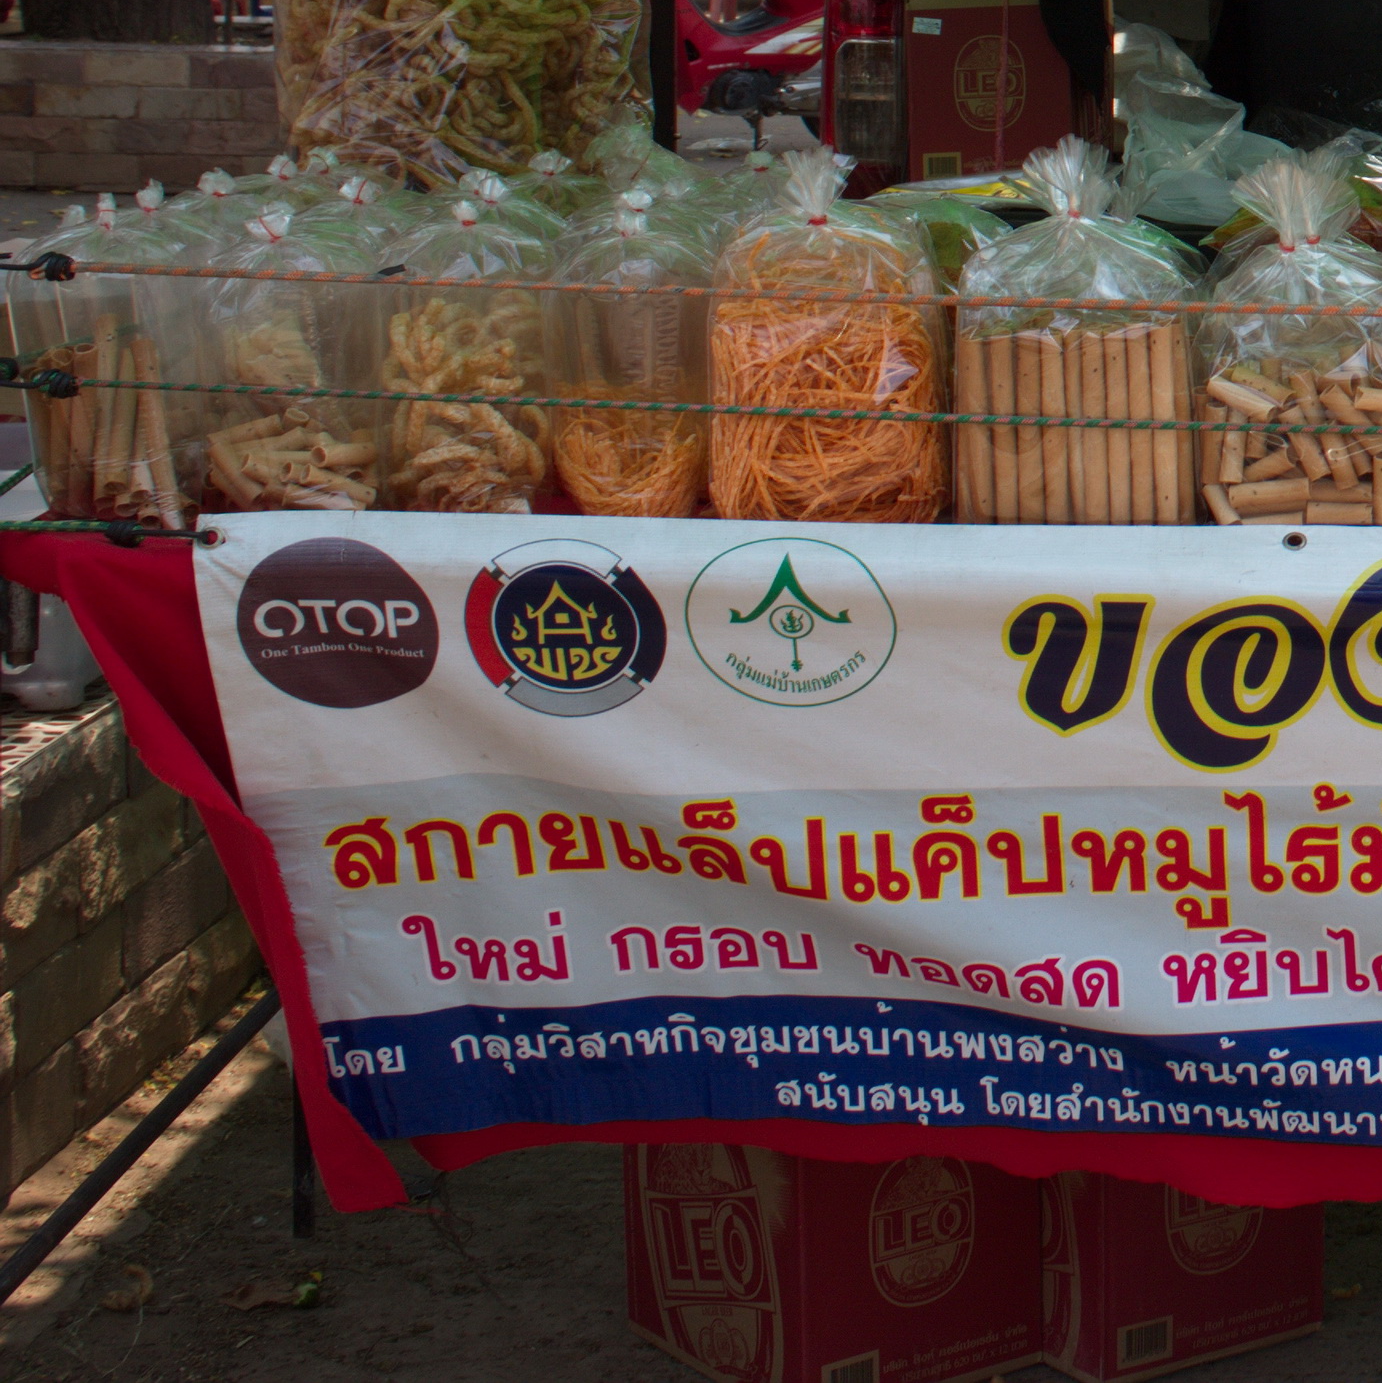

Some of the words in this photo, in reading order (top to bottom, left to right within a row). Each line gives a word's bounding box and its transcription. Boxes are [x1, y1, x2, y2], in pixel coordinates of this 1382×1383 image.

[253, 599, 420, 639] OTOP
[261, 647, 289, 659] One
[291, 641, 345, 655] Tambon
[348, 642, 374, 654] One
[375, 645, 425, 658] Product
[724, 650, 868, 694] กลุ่มแม่บ้านเกษตรกร
[402, 911, 571, 983] ใหม่
[609, 924, 820, 973] กรอบ
[853, 940, 1122, 1008] ทอดสด
[323, 1035, 406, 1078] โดย
[451, 1001, 1124, 1074] กลุ่มวิสาหกิจชุมชนบ้านพงสว่าง
[775, 1073, 966, 1126] สนับสนุน
[653, 1198, 764, 1300] LEO
[875, 1196, 971, 1261] LEO
